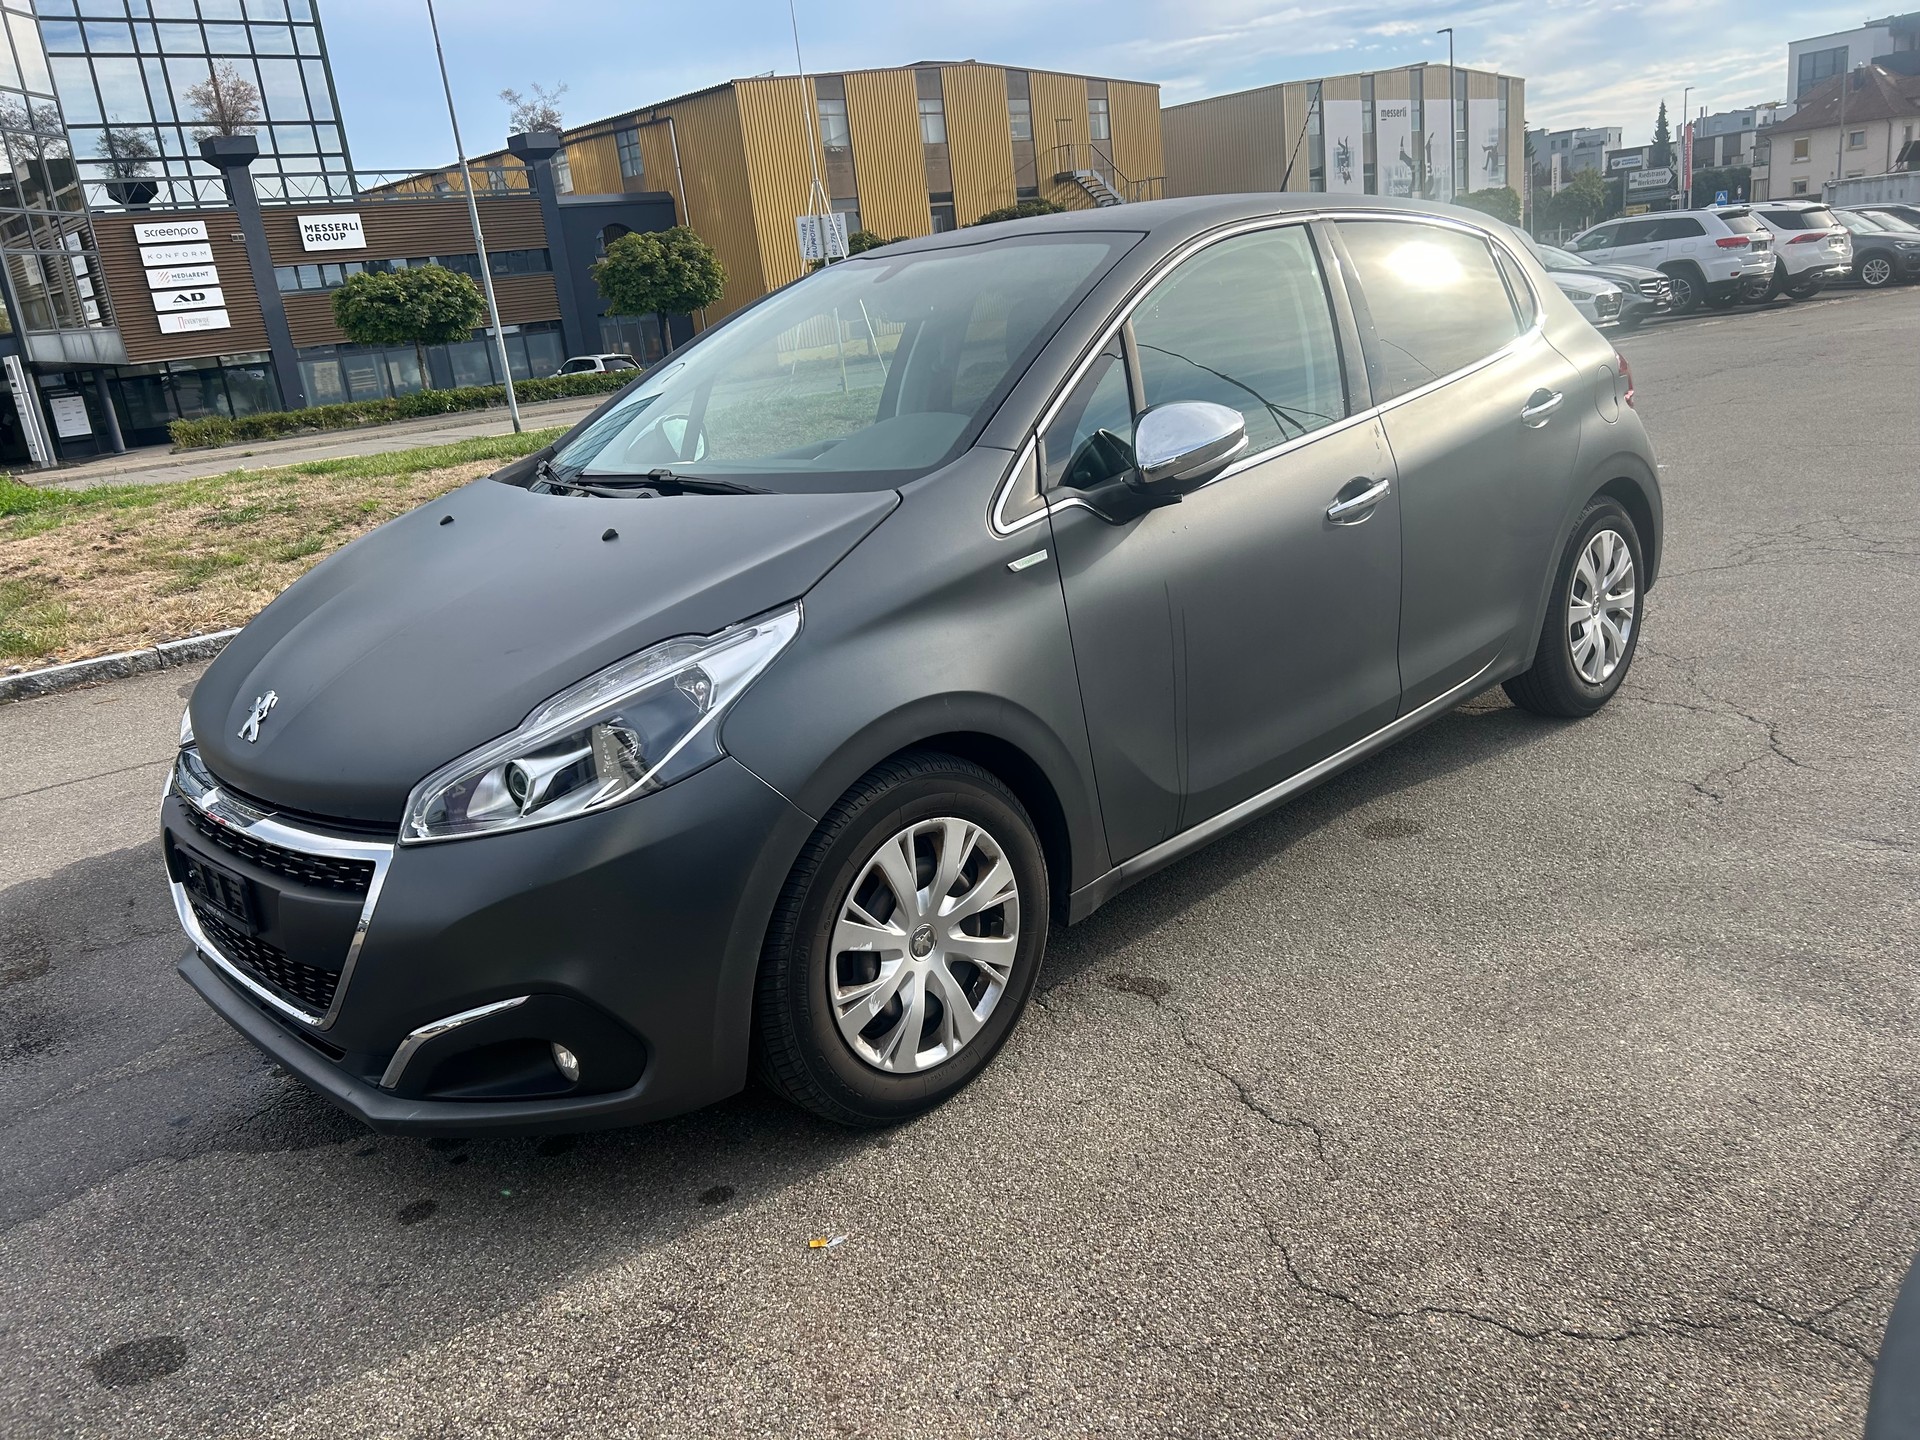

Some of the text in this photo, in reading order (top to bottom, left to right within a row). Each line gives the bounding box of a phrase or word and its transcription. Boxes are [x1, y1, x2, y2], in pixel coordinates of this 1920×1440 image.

[1381, 106, 1406, 117] messerli
[1639, 170, 1667, 178] Riedstrasse
[1637, 178, 1667, 187] Werkstrasse
[143, 227, 198, 237] screenpro
[304, 222, 359, 233] MESSERLI
[306, 232, 346, 242] GROUP
[147, 250, 207, 259] KONFORM
[171, 271, 209, 279] MEDIARENT
[172, 292, 206, 303] AD
